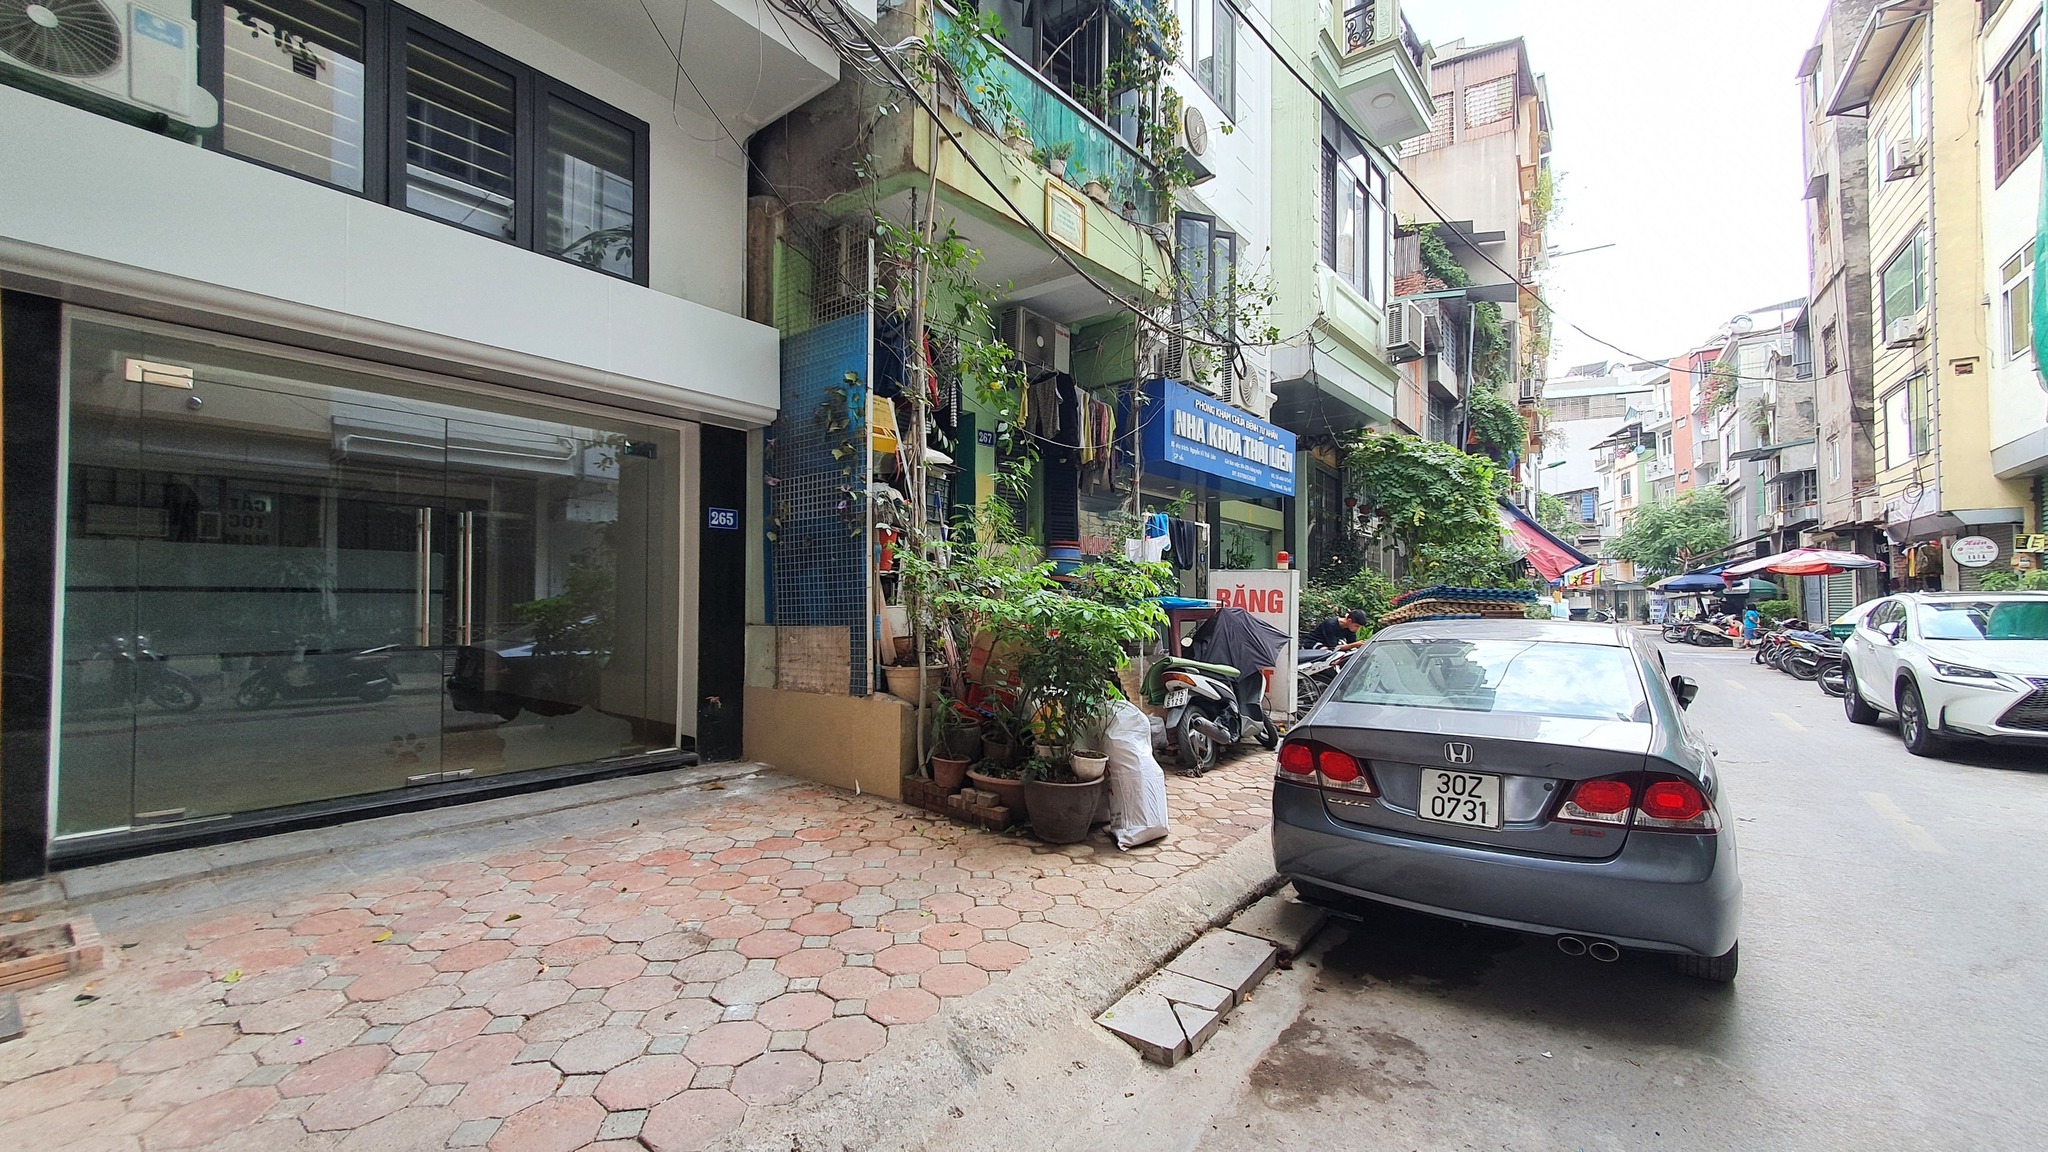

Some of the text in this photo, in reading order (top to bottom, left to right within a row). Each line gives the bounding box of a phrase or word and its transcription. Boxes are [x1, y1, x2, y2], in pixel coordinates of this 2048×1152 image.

[1195, 399, 1215, 415] PHÒNG
[1215, 407, 1231, 421] KHÁM
[979, 431, 992, 444] 267
[1173, 408, 1206, 444] NHA
[1206, 421, 1242, 457] KHOA
[1242, 435, 1268, 466] THÁI
[1268, 444, 1293, 473] LIÊN
[711, 511, 734, 526] 265
[1437, 773, 1483, 799] 30Z
[1431, 796, 1486, 824] 0731
